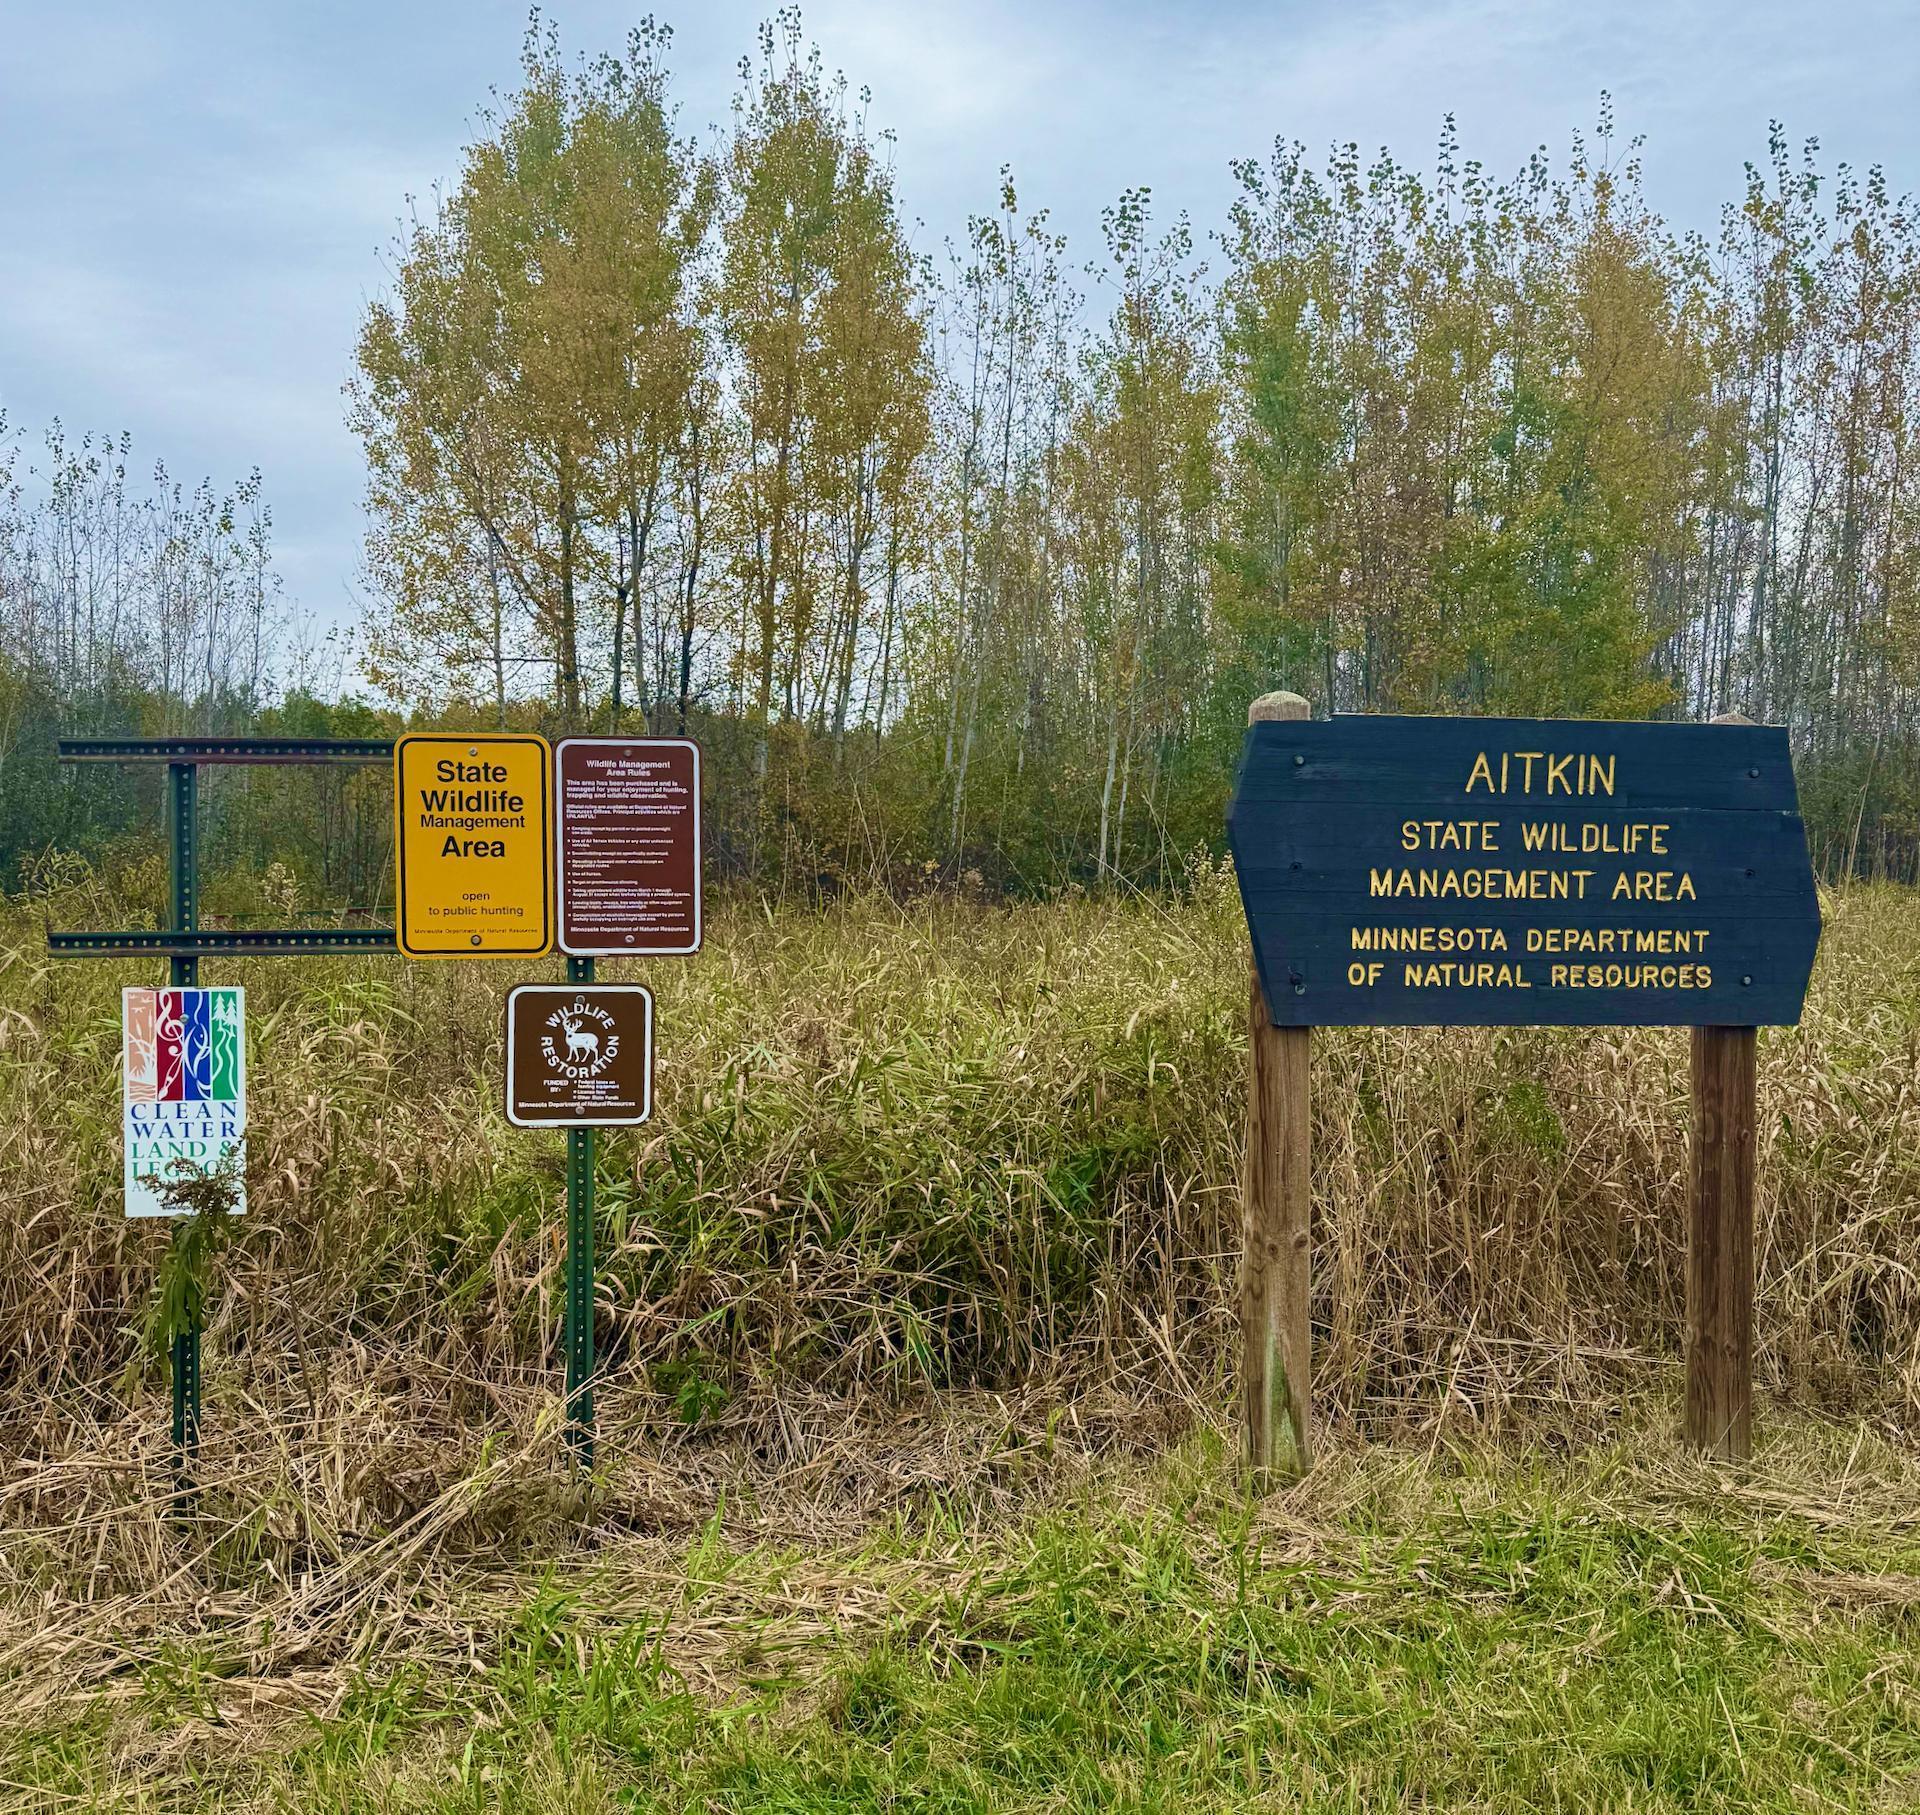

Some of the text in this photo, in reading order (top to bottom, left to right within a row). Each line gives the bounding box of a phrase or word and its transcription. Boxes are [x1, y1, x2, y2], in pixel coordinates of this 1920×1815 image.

[437, 760, 507, 783] State
[586, 760, 670, 769] Wildlife Management
[1464, 751, 1616, 797] AITKIN
[421, 790, 524, 812] Wildlife
[421, 814, 525, 830] Management
[441, 836, 505, 858] Area
[1401, 820, 1671, 855] STATE WILDLIFE
[1369, 868, 1697, 901] MANAGEMENT AREA
[462, 892, 490, 903] open
[428, 906, 524, 917] to public hunting
[1350, 927, 1710, 953] MINNESOTA DEPARTMENT
[1347, 962, 1712, 989] OF NATURAL RESOURCES
[545, 1002, 616, 1030] WILDLIFE
[541, 1036, 619, 1079] RESTORATION
[131, 1102, 238, 1120] CLEAN
[132, 1122, 237, 1139] WATER
[131, 1140, 232, 1158] LAND &
